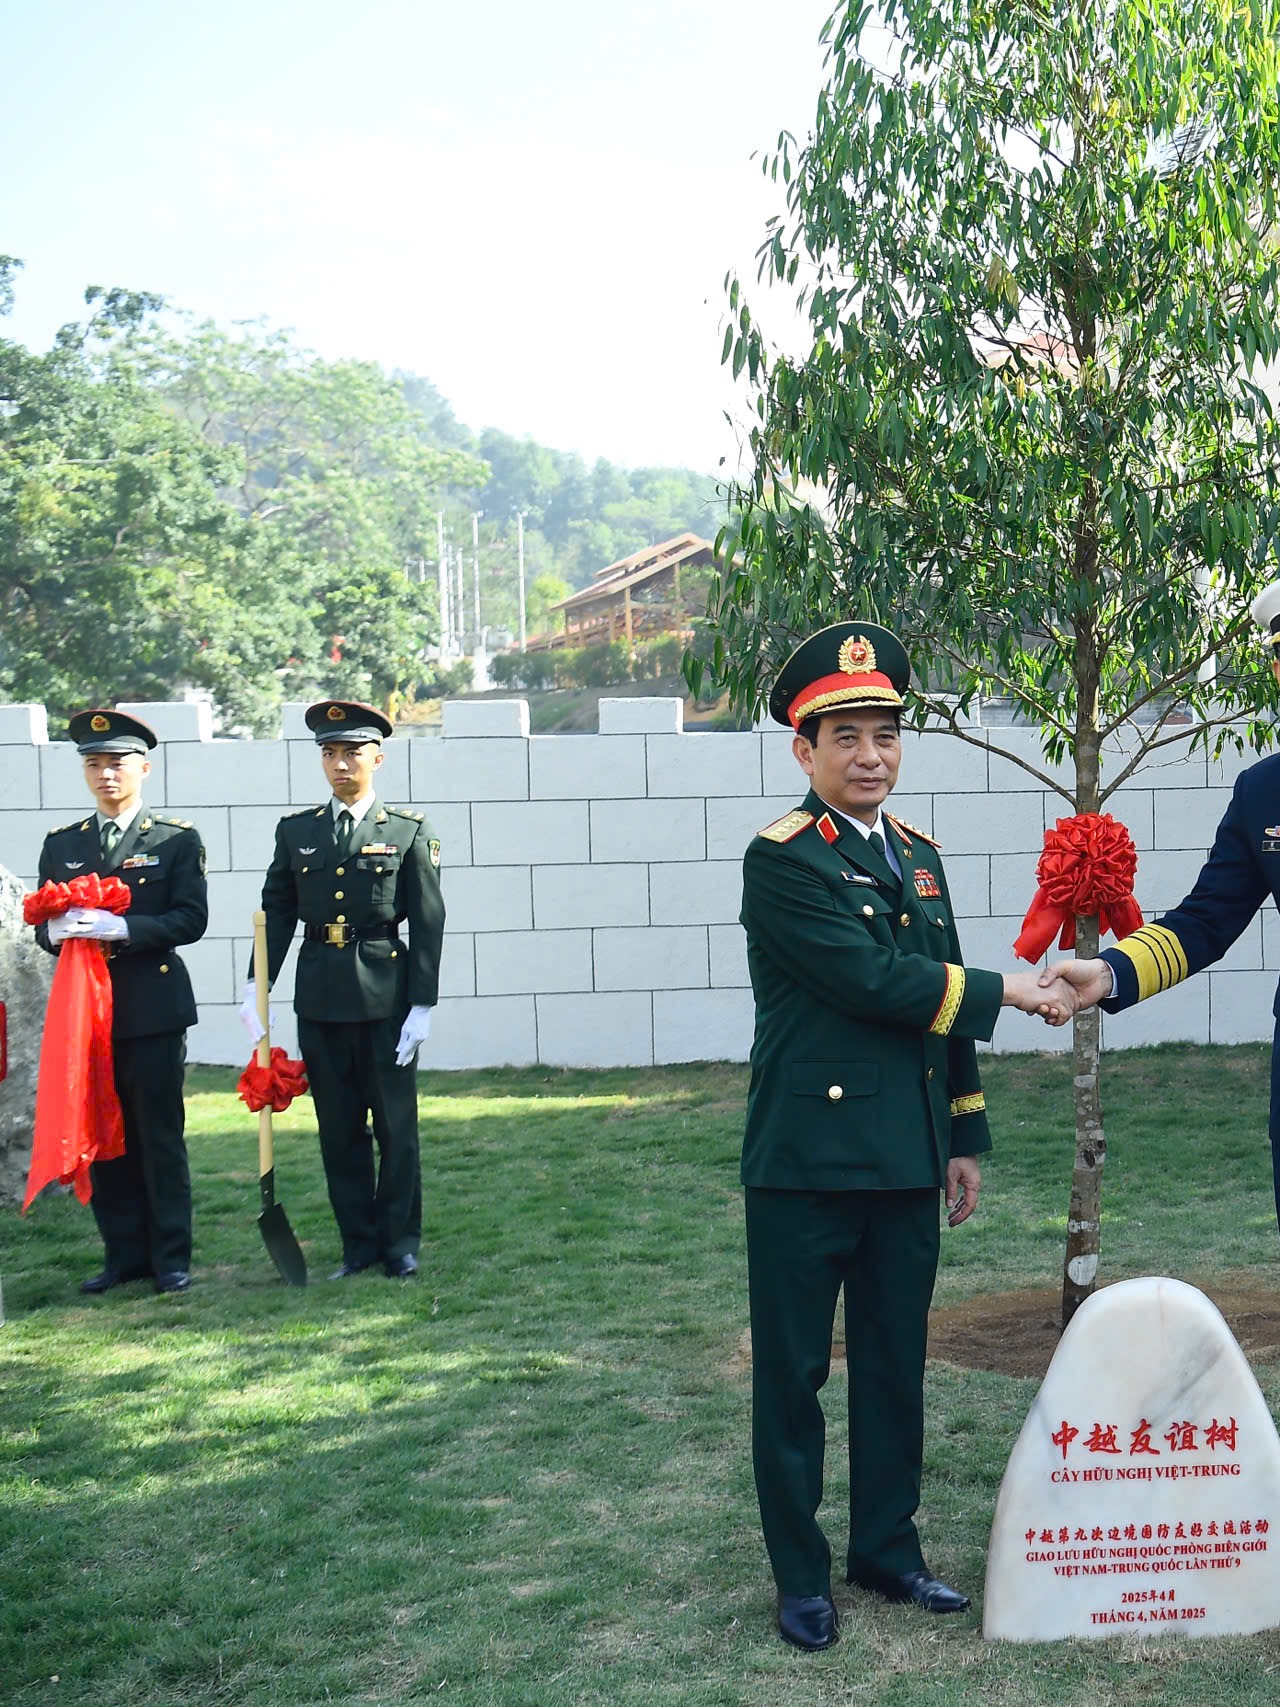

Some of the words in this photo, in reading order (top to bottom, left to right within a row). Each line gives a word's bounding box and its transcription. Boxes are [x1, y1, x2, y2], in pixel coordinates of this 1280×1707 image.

[1051, 1416, 1240, 1461] 中越友谊树
[1051, 1467, 1080, 1483] CÂY
[1083, 1466, 1113, 1482] HỮU
[1117, 1467, 1152, 1482] NGHỊ
[1155, 1464, 1241, 1481] VIỆT-TRUNG
[1025, 1519, 1269, 1547] 中越第九次边境国防友好交流活动
[1026, 1551, 1055, 1562] GIAO
[1057, 1549, 1080, 1560] LƯU
[1083, 1547, 1107, 1559] HỮU
[1109, 1547, 1137, 1559] NGHỊ
[1173, 1542, 1212, 1555] PHÒNG
[1214, 1540, 1240, 1553] BIÊN
[1242, 1539, 1267, 1552] GIỚI
[1054, 1564, 1080, 1578] VIỆT
[1082, 1562, 1150, 1575] NAM-TRUNG
[1209, 1555, 1234, 1568] THỨ
[1235, 1558, 1241, 1567] 9
[1121, 1589, 1175, 1603] 2025年4月
[1090, 1609, 1135, 1624] THÁNG
[1137, 1611, 1147, 1625] 4,
[1149, 1607, 1178, 1621] NĂM
[1181, 1608, 1206, 1619] 2025
